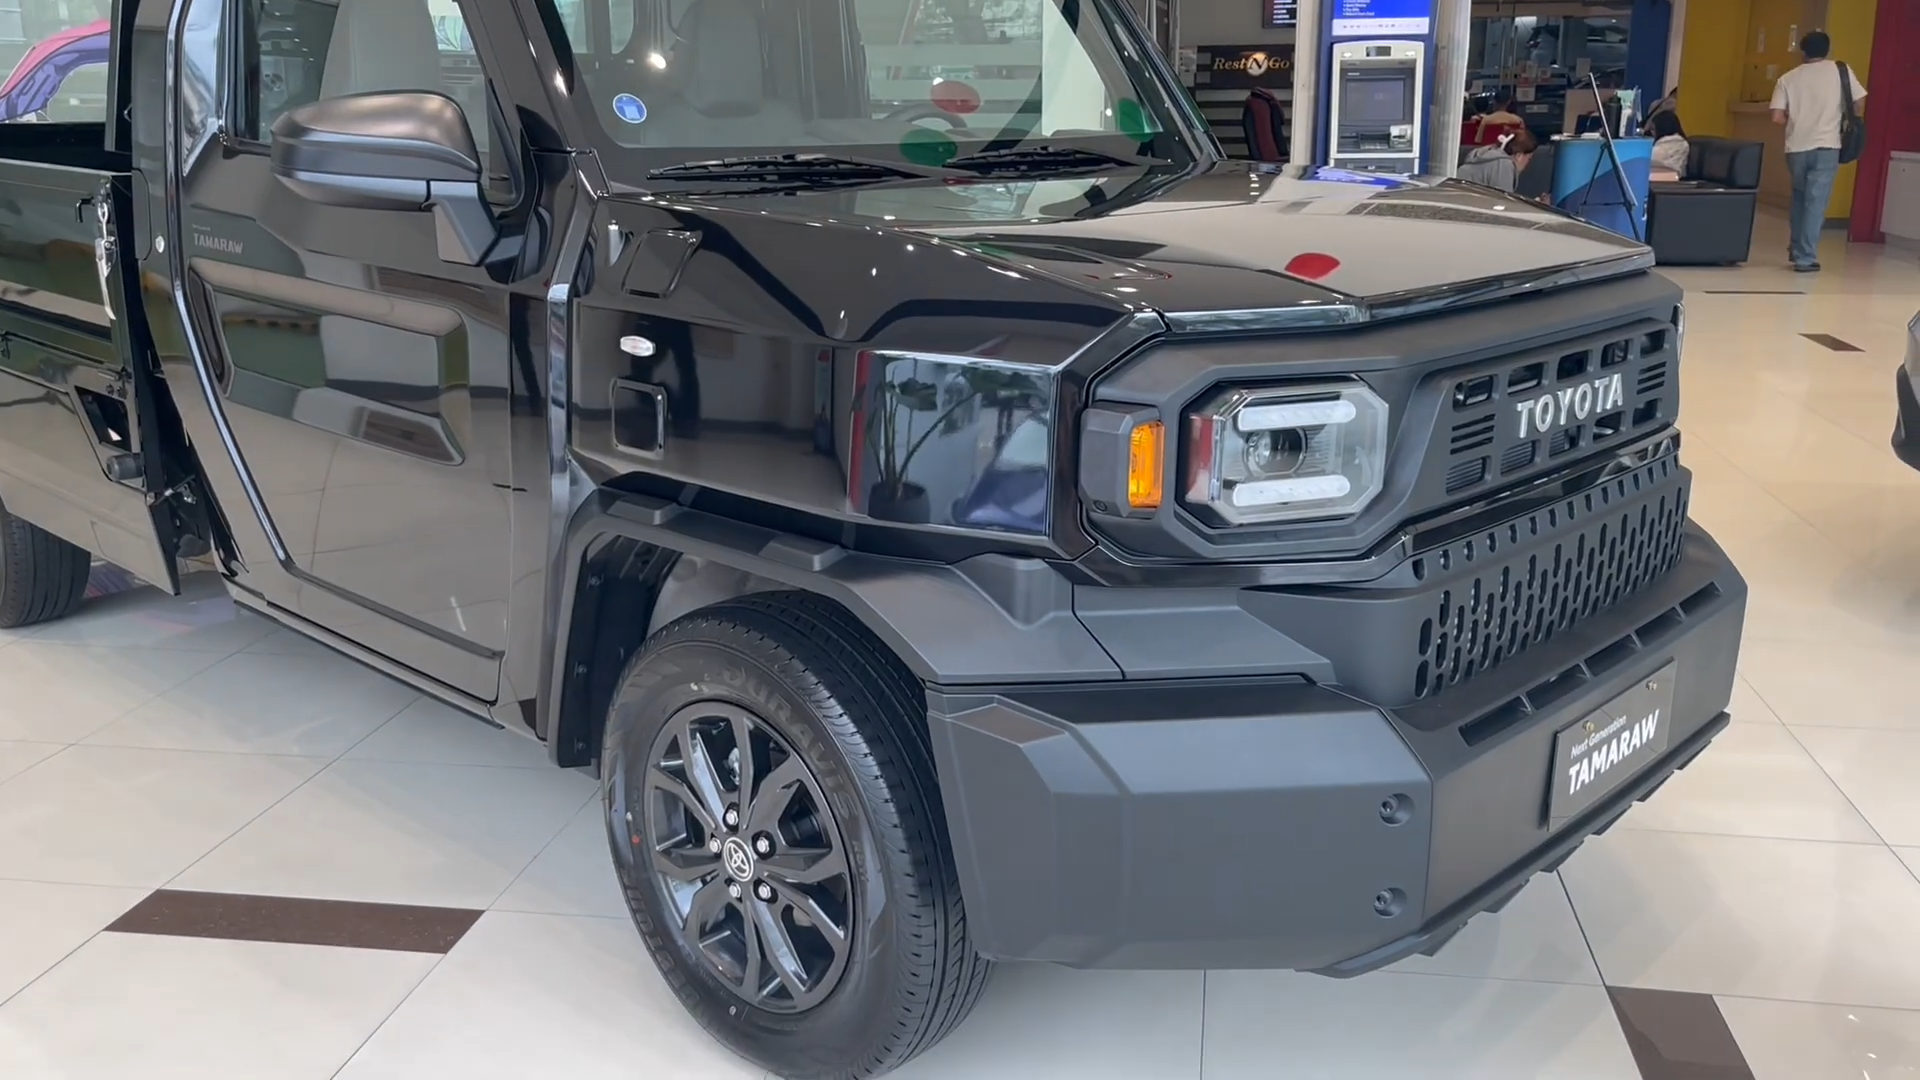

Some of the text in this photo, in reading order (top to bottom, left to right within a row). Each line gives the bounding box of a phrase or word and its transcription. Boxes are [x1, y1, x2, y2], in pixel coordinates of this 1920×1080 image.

[1213, 57, 1247, 70] Rest
[1269, 57, 1290, 69] Go
[193, 232, 243, 254] TAMARAW
[1516, 373, 1624, 439] TOYOTA
[1568, 708, 1659, 796] TAMARAW
[1570, 715, 1627, 759] Next Generation
